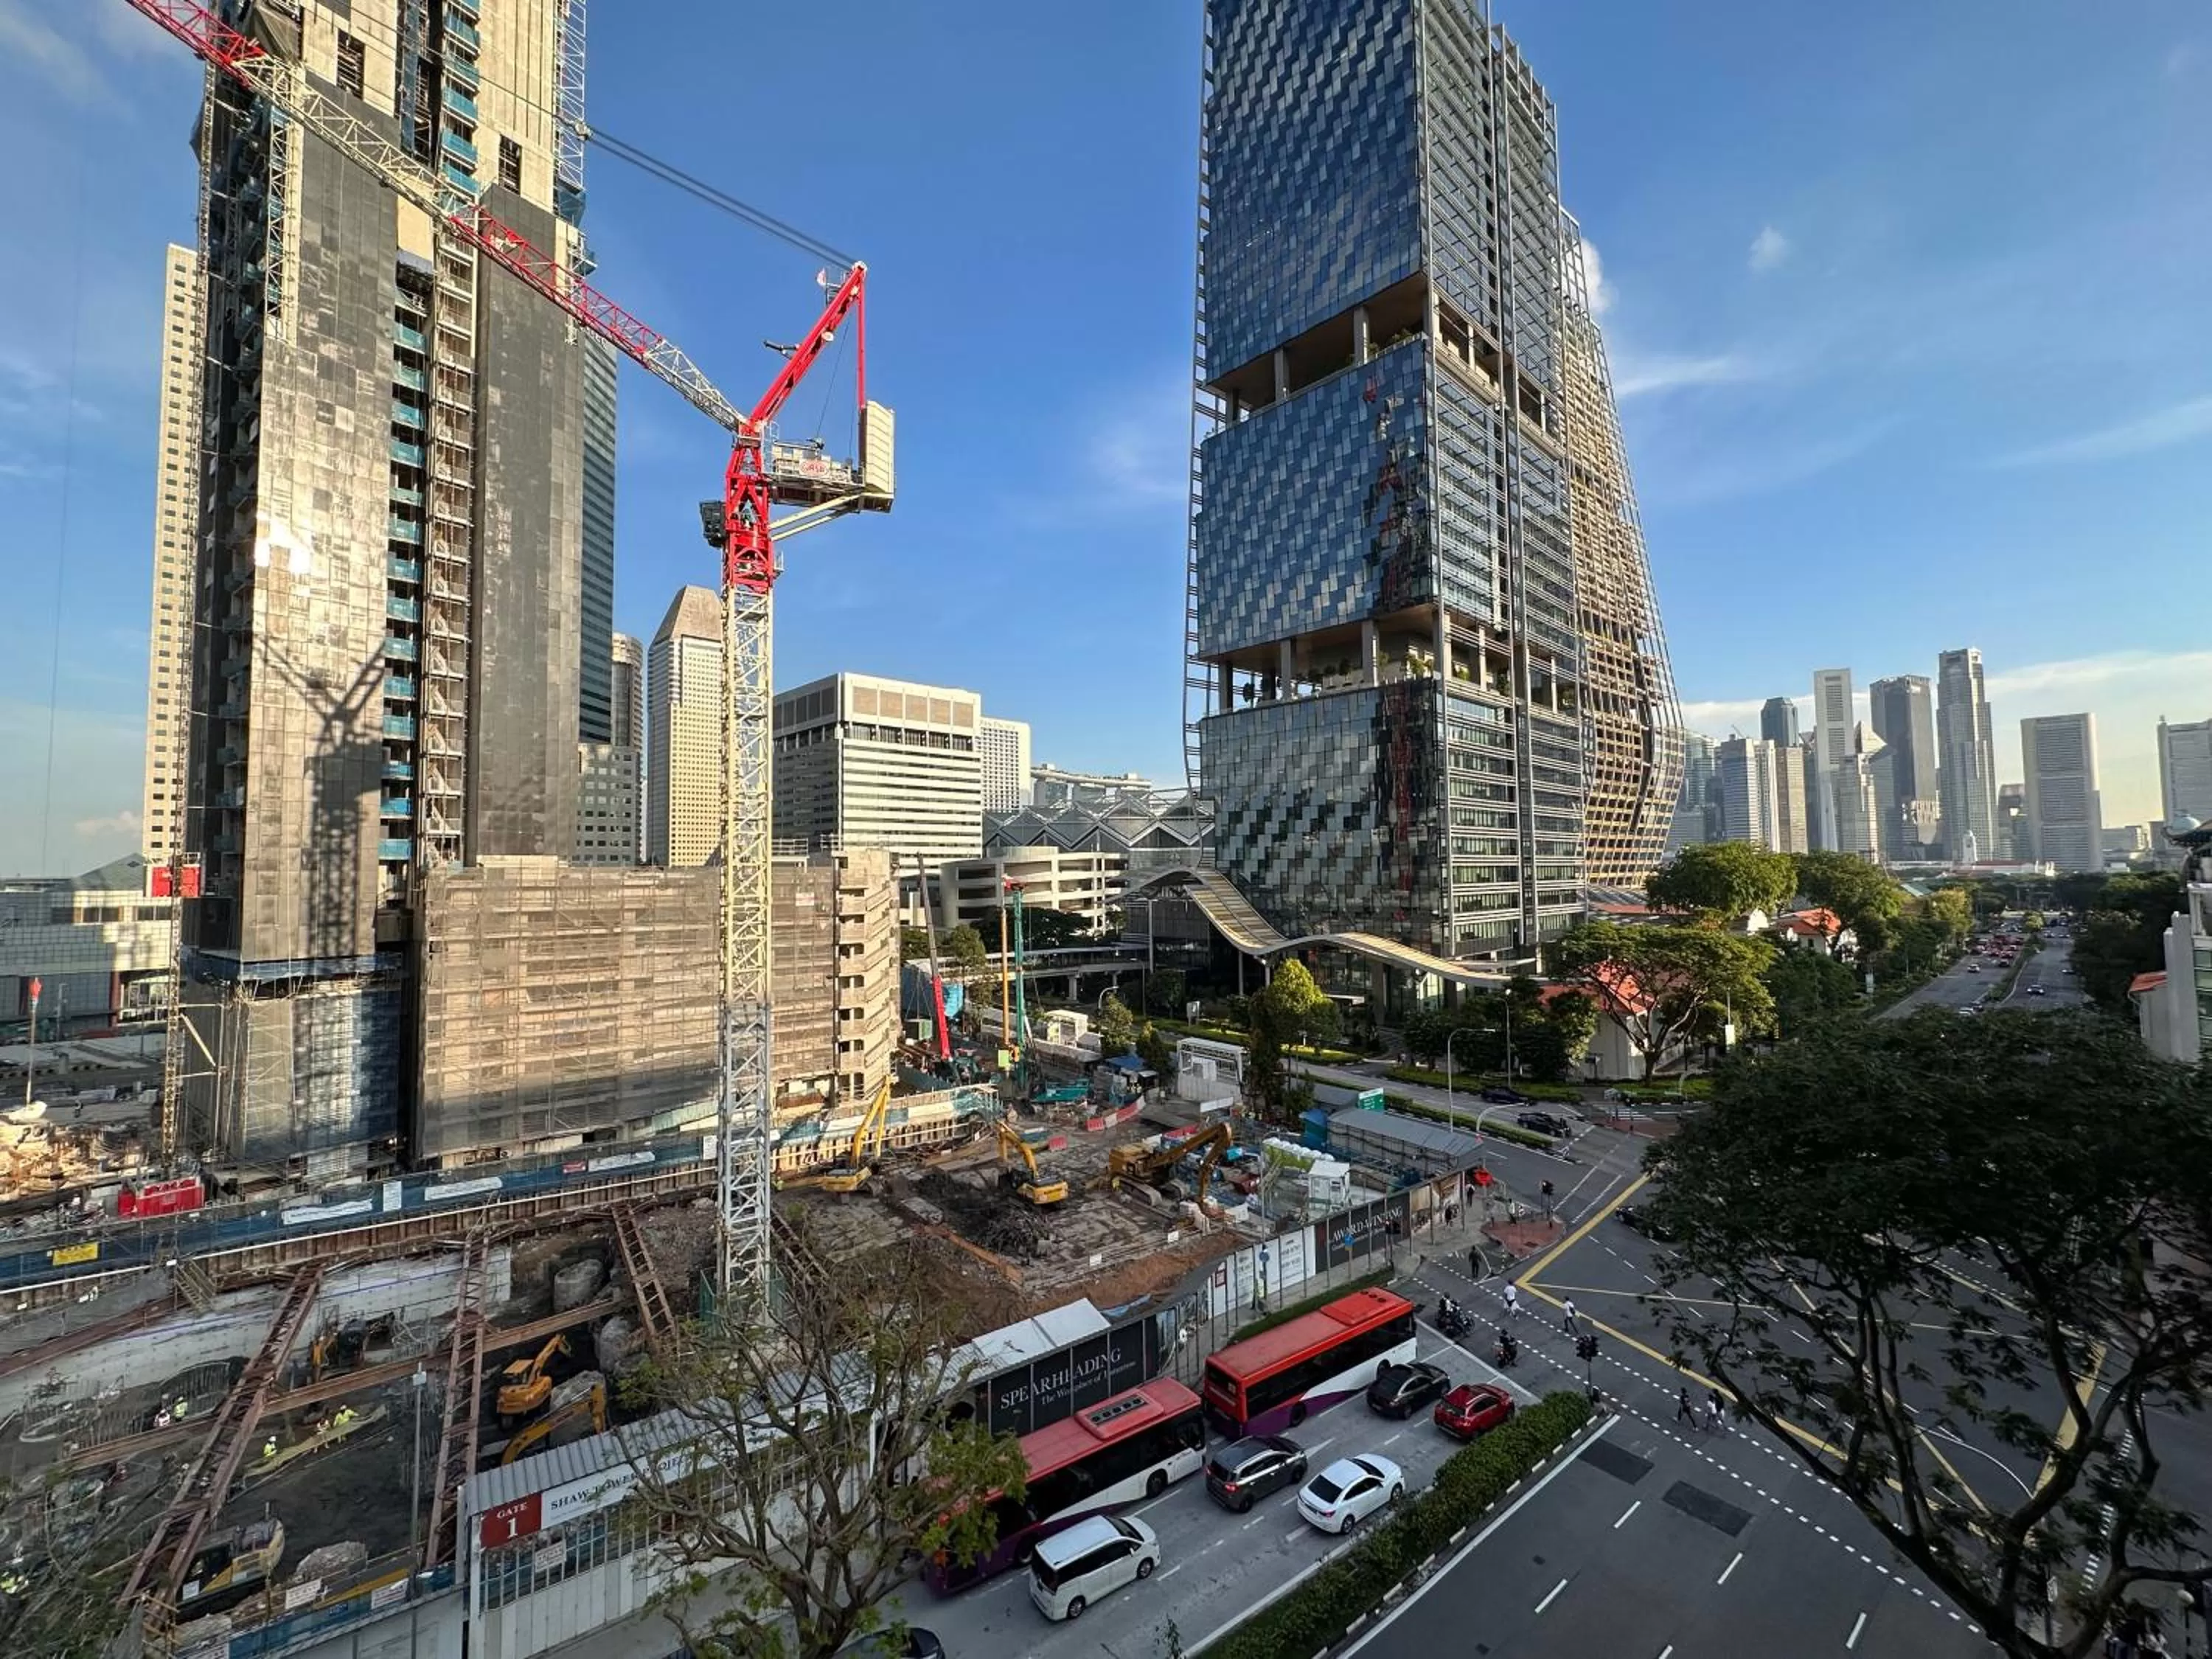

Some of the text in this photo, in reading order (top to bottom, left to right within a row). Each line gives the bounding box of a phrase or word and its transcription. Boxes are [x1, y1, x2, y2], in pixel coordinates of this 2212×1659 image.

[551, 1489, 589, 1510] SHAW
[496, 1502, 528, 1519] GATE
[507, 1517, 518, 1539] 1
